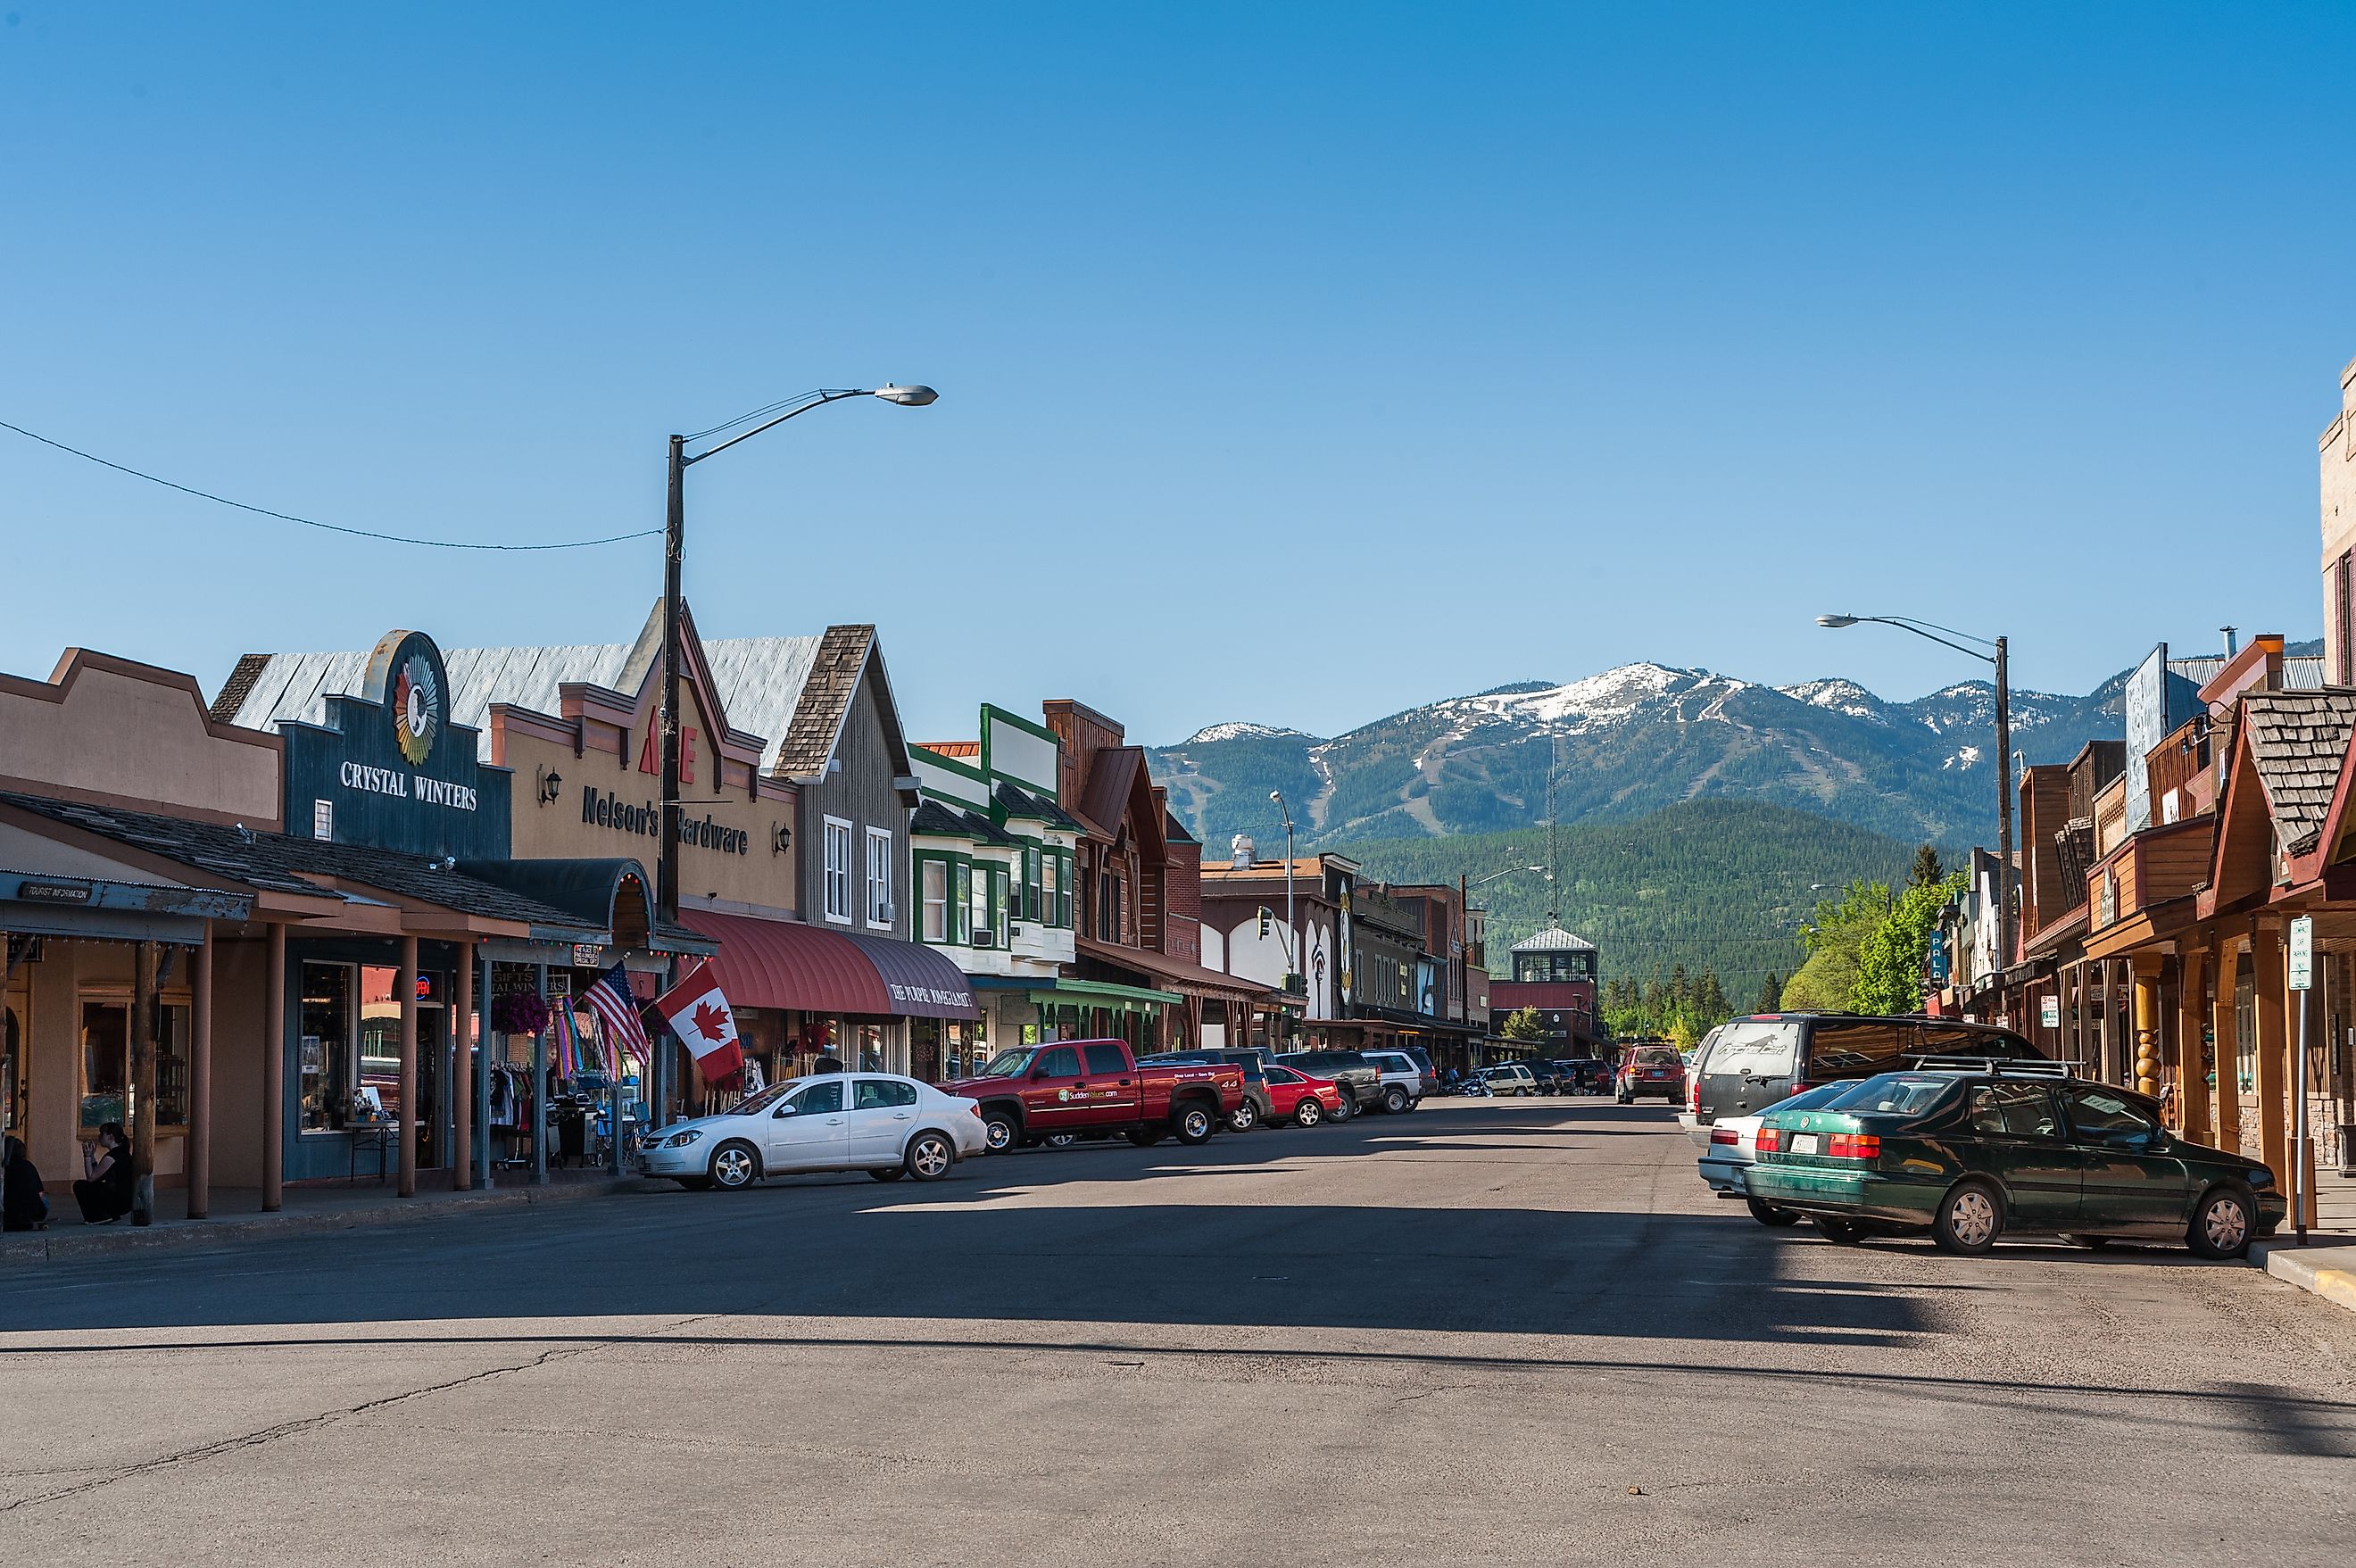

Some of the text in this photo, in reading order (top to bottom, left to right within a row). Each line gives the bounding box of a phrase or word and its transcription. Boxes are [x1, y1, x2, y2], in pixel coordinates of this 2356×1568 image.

[638, 705, 697, 784] AE
[339, 760, 477, 812] CRYSTAL WINTERS
[582, 785, 659, 837] Nelson's
[29, 886, 87, 899] TOURIST INFORMATION
[492, 972, 534, 983] GIFTS
[890, 983, 906, 1000] THE
[904, 986, 930, 1004] PURPLE
